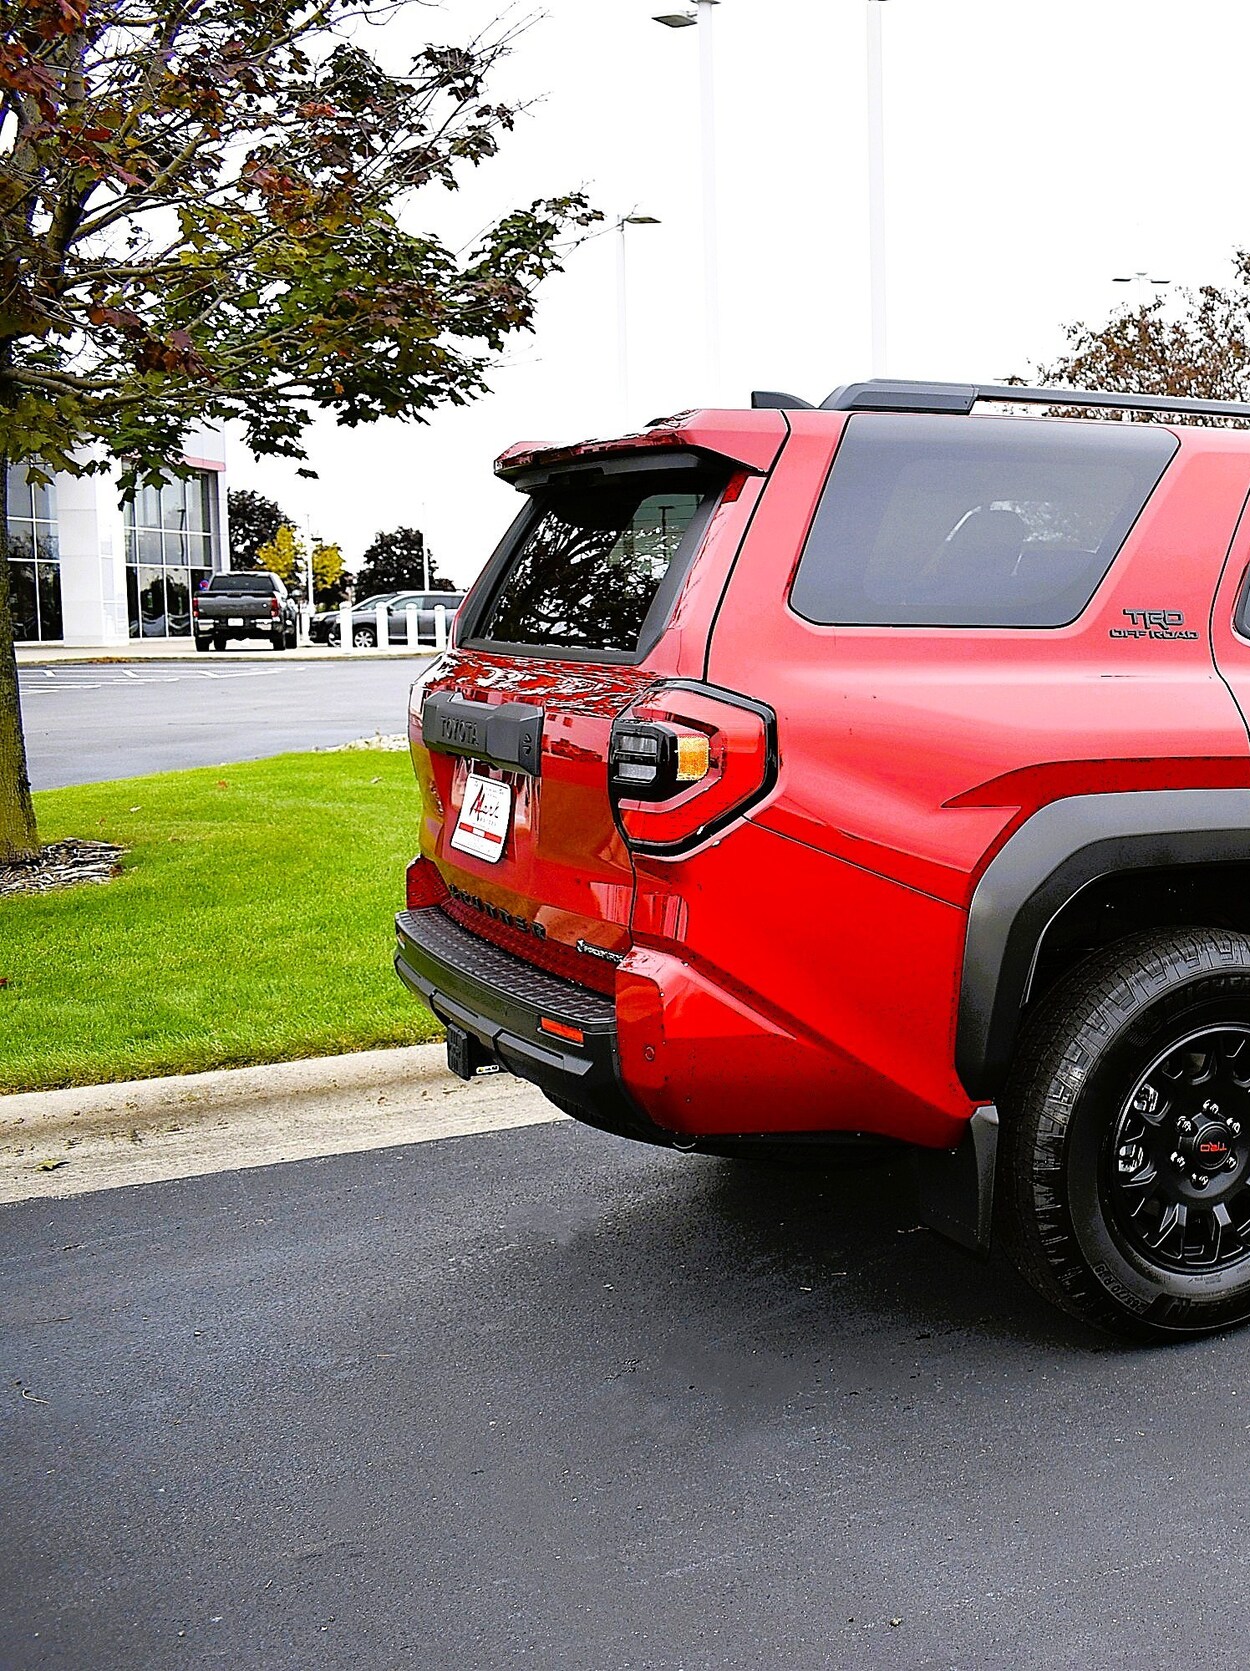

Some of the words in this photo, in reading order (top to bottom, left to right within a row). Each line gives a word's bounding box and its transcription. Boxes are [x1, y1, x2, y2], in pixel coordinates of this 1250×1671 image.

[1122, 609, 1184, 630] TRD
[1109, 629, 1147, 639] OFF
[1149, 630, 1199, 640] ROAD
[440, 715, 480, 746] TOYOTA
[1200, 1140, 1228, 1152] TRD
